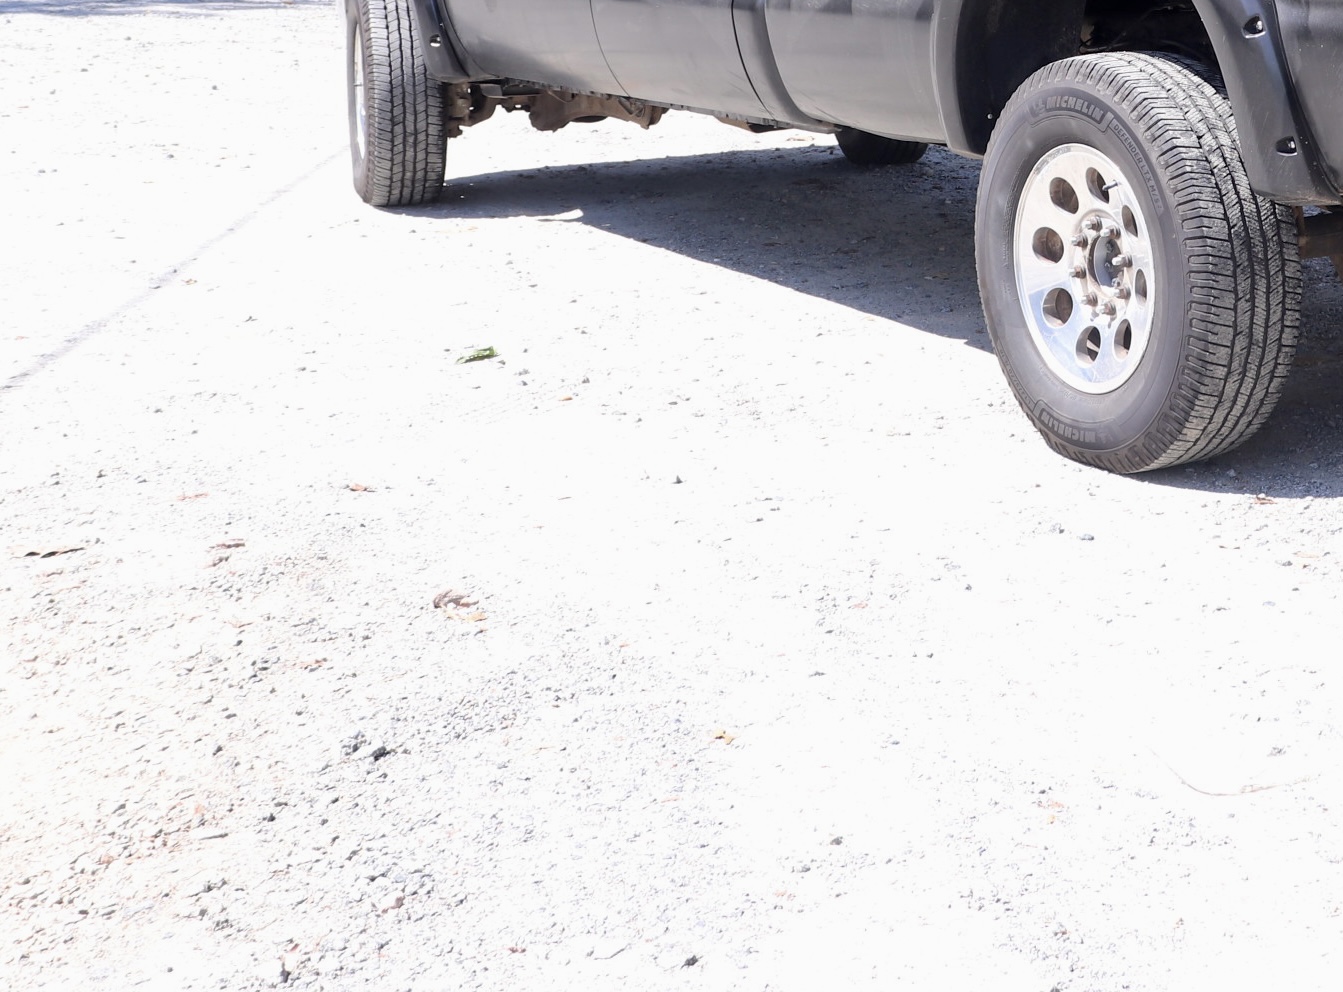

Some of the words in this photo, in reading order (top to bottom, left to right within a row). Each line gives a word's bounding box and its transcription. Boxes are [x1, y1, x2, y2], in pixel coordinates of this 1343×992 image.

[1046, 95, 1104, 123] MICHELIN
[1113, 123, 1143, 165] DEFENDER
[1041, 411, 1096, 443] MICHELIN
